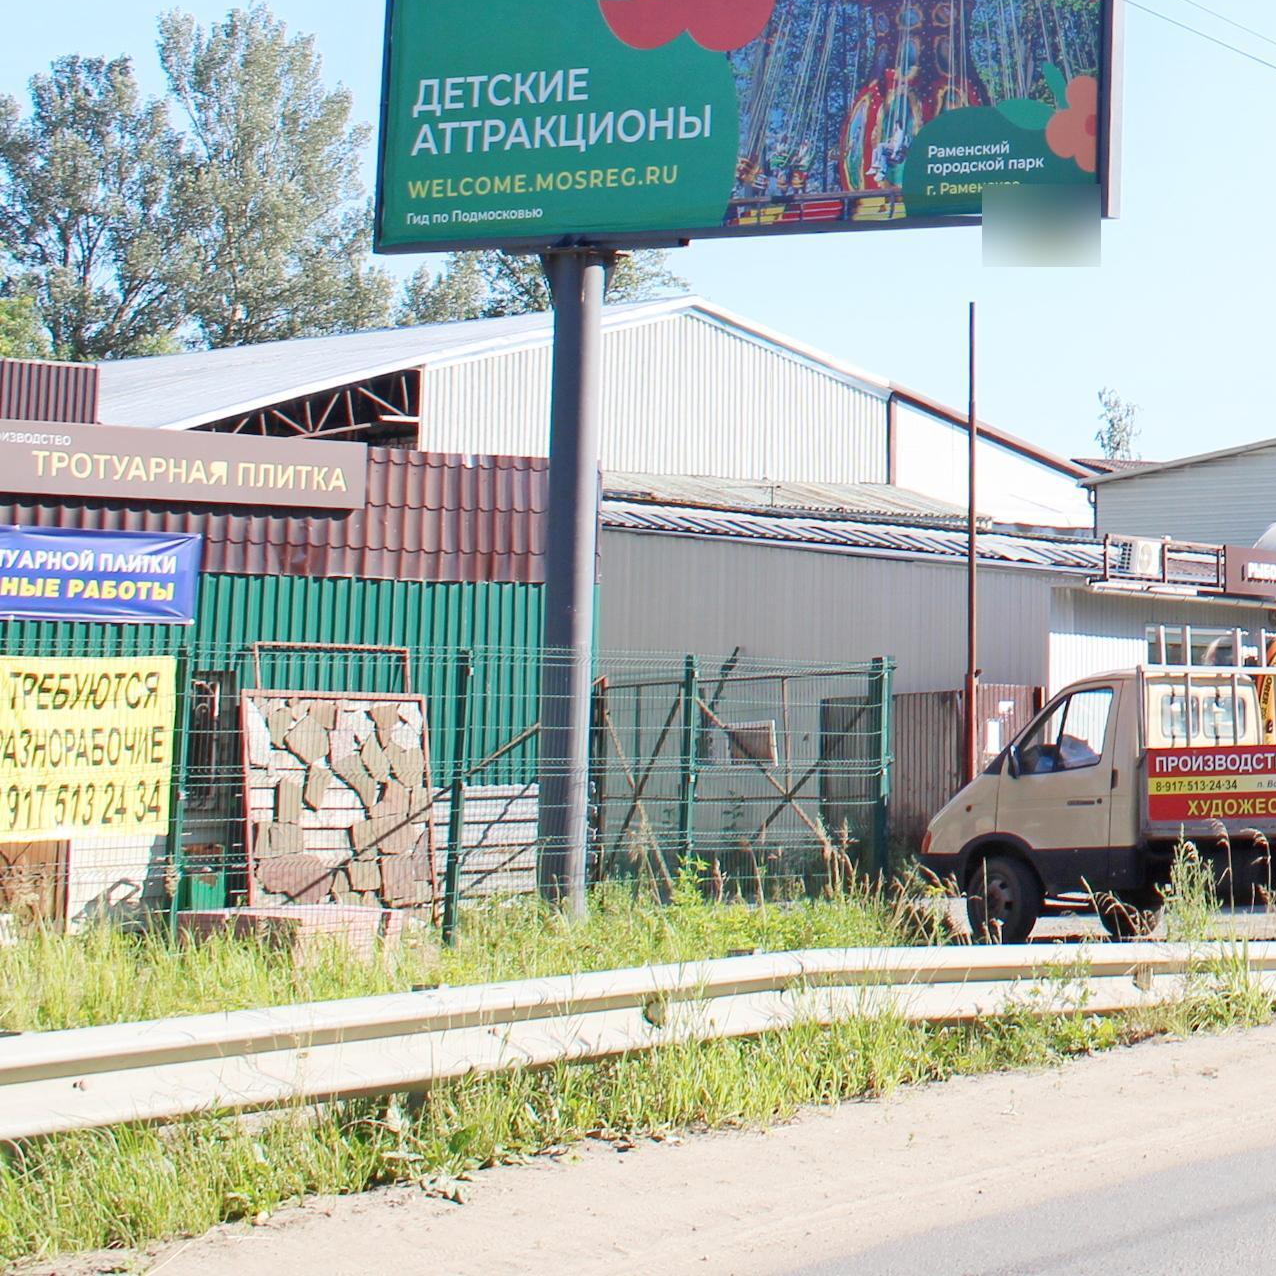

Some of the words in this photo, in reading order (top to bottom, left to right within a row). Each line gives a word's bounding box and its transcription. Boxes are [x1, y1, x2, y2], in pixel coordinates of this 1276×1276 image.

[412, 67, 589, 118] ДЕТСКИЕ
[410, 104, 712, 156] АТТРАКЦИОНЫ
[927, 140, 1010, 158] Раменский
[927, 157, 1005, 176] городской
[1008, 157, 1045, 172] парк
[408, 165, 678, 199] WELCOME.MOSREG.RU
[406, 212, 430, 226] Гид
[432, 213, 449, 224] по
[452, 207, 543, 224] Подмосковью
[32, 450, 228, 486] ТРОТУАРНАЯ
[237, 462, 348, 493] ПЛИТКА
[99, 553, 177, 574] ПЛИТКИ
[67, 579, 175, 601] РАБОТЫ
[10, 672, 160, 710] ТРЕБУЮТСЯ
[1155, 779, 1238, 792] 8-917-513-24-34
[55, 782, 96, 826] 513
[101, 780, 127, 824] 24
[135, 778, 161, 822] 34
